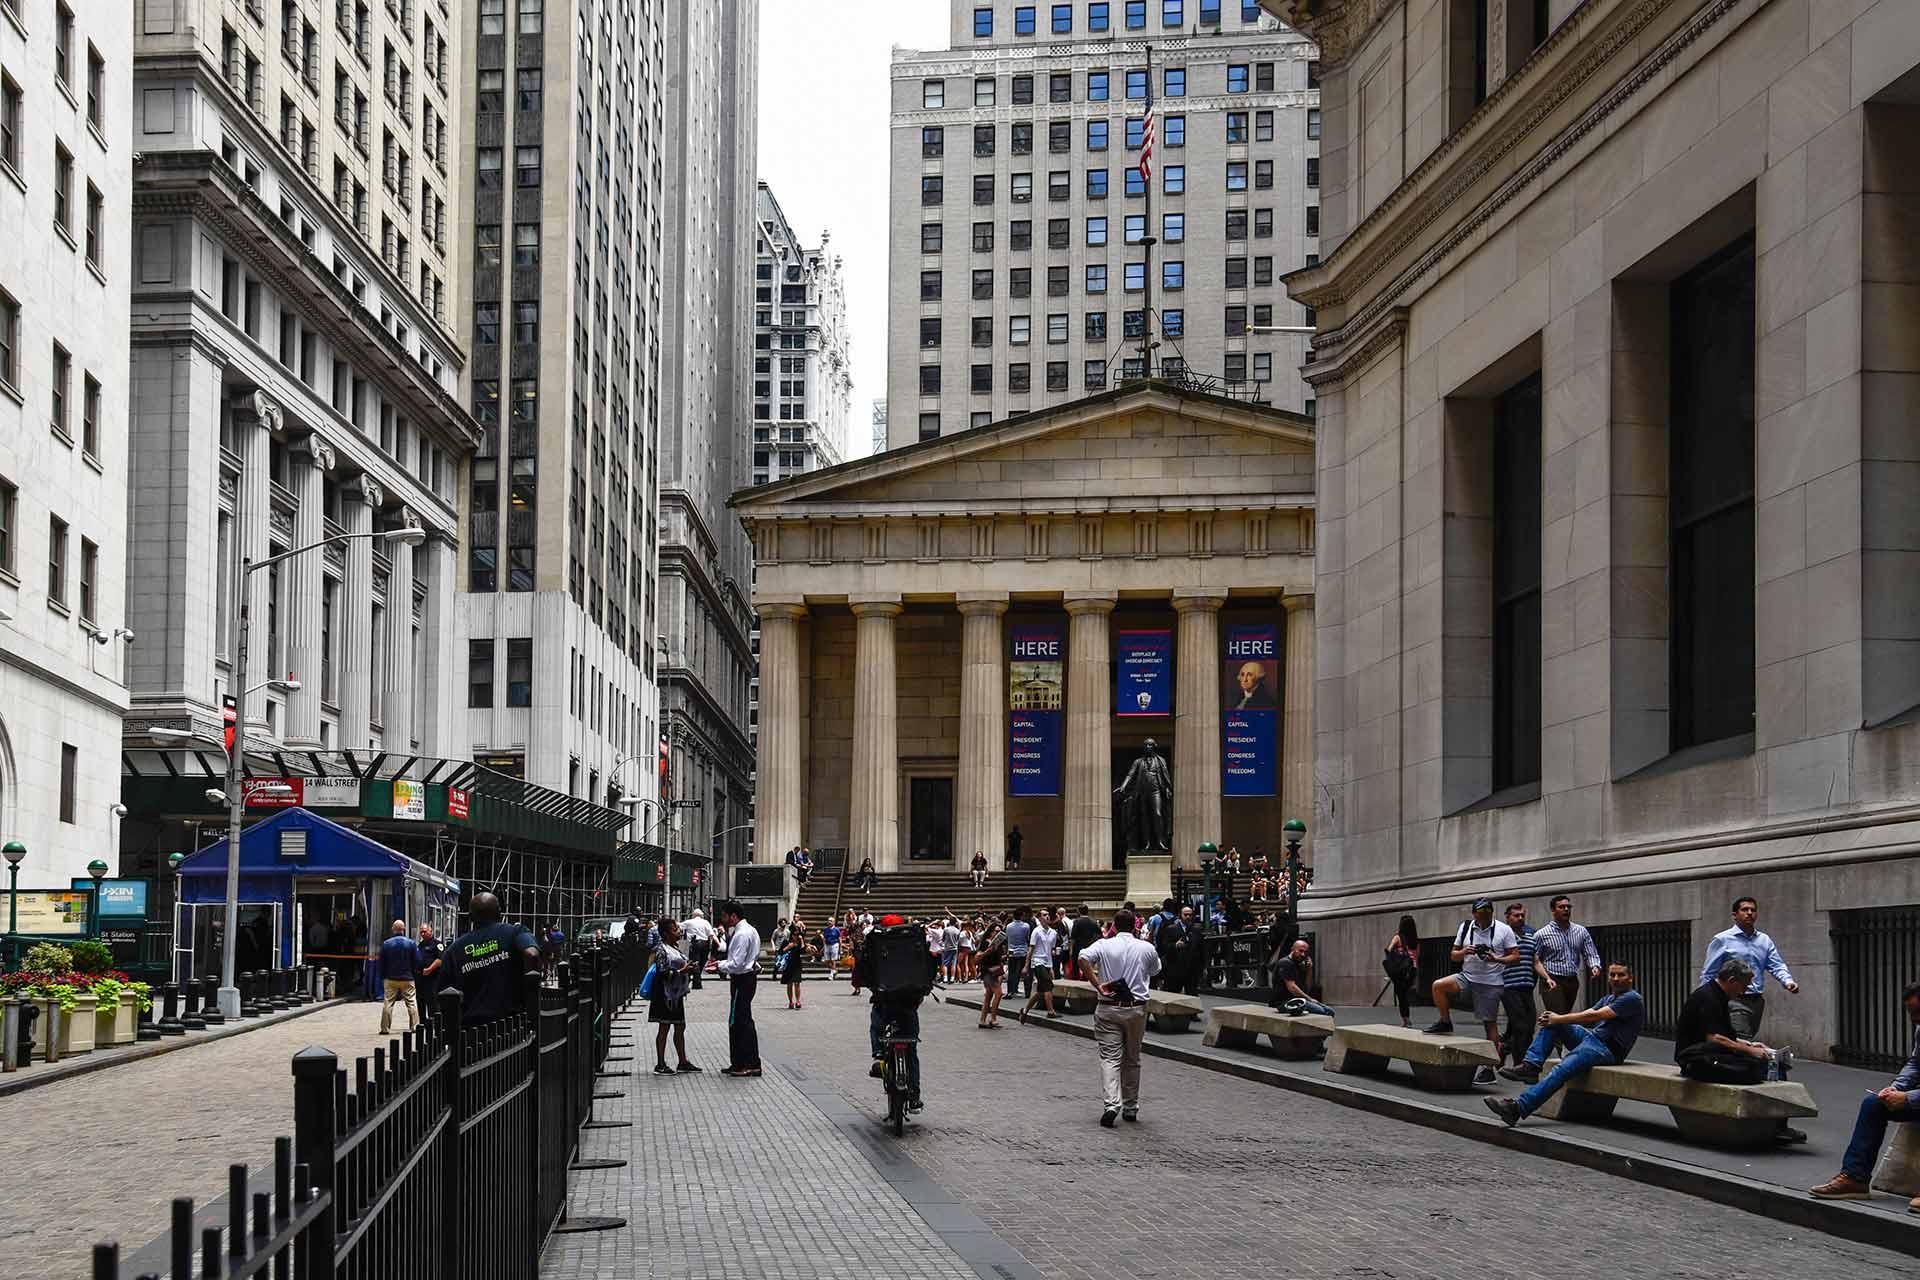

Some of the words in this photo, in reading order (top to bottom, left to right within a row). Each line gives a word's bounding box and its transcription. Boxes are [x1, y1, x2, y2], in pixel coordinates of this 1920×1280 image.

[1015, 641, 1059, 656] HERE
[1229, 640, 1273, 655] HERE
[305, 778, 312, 787] 14
[314, 778, 334, 787] WALL
[334, 778, 359, 787] STREET
[1233, 941, 1251, 953] Subway
